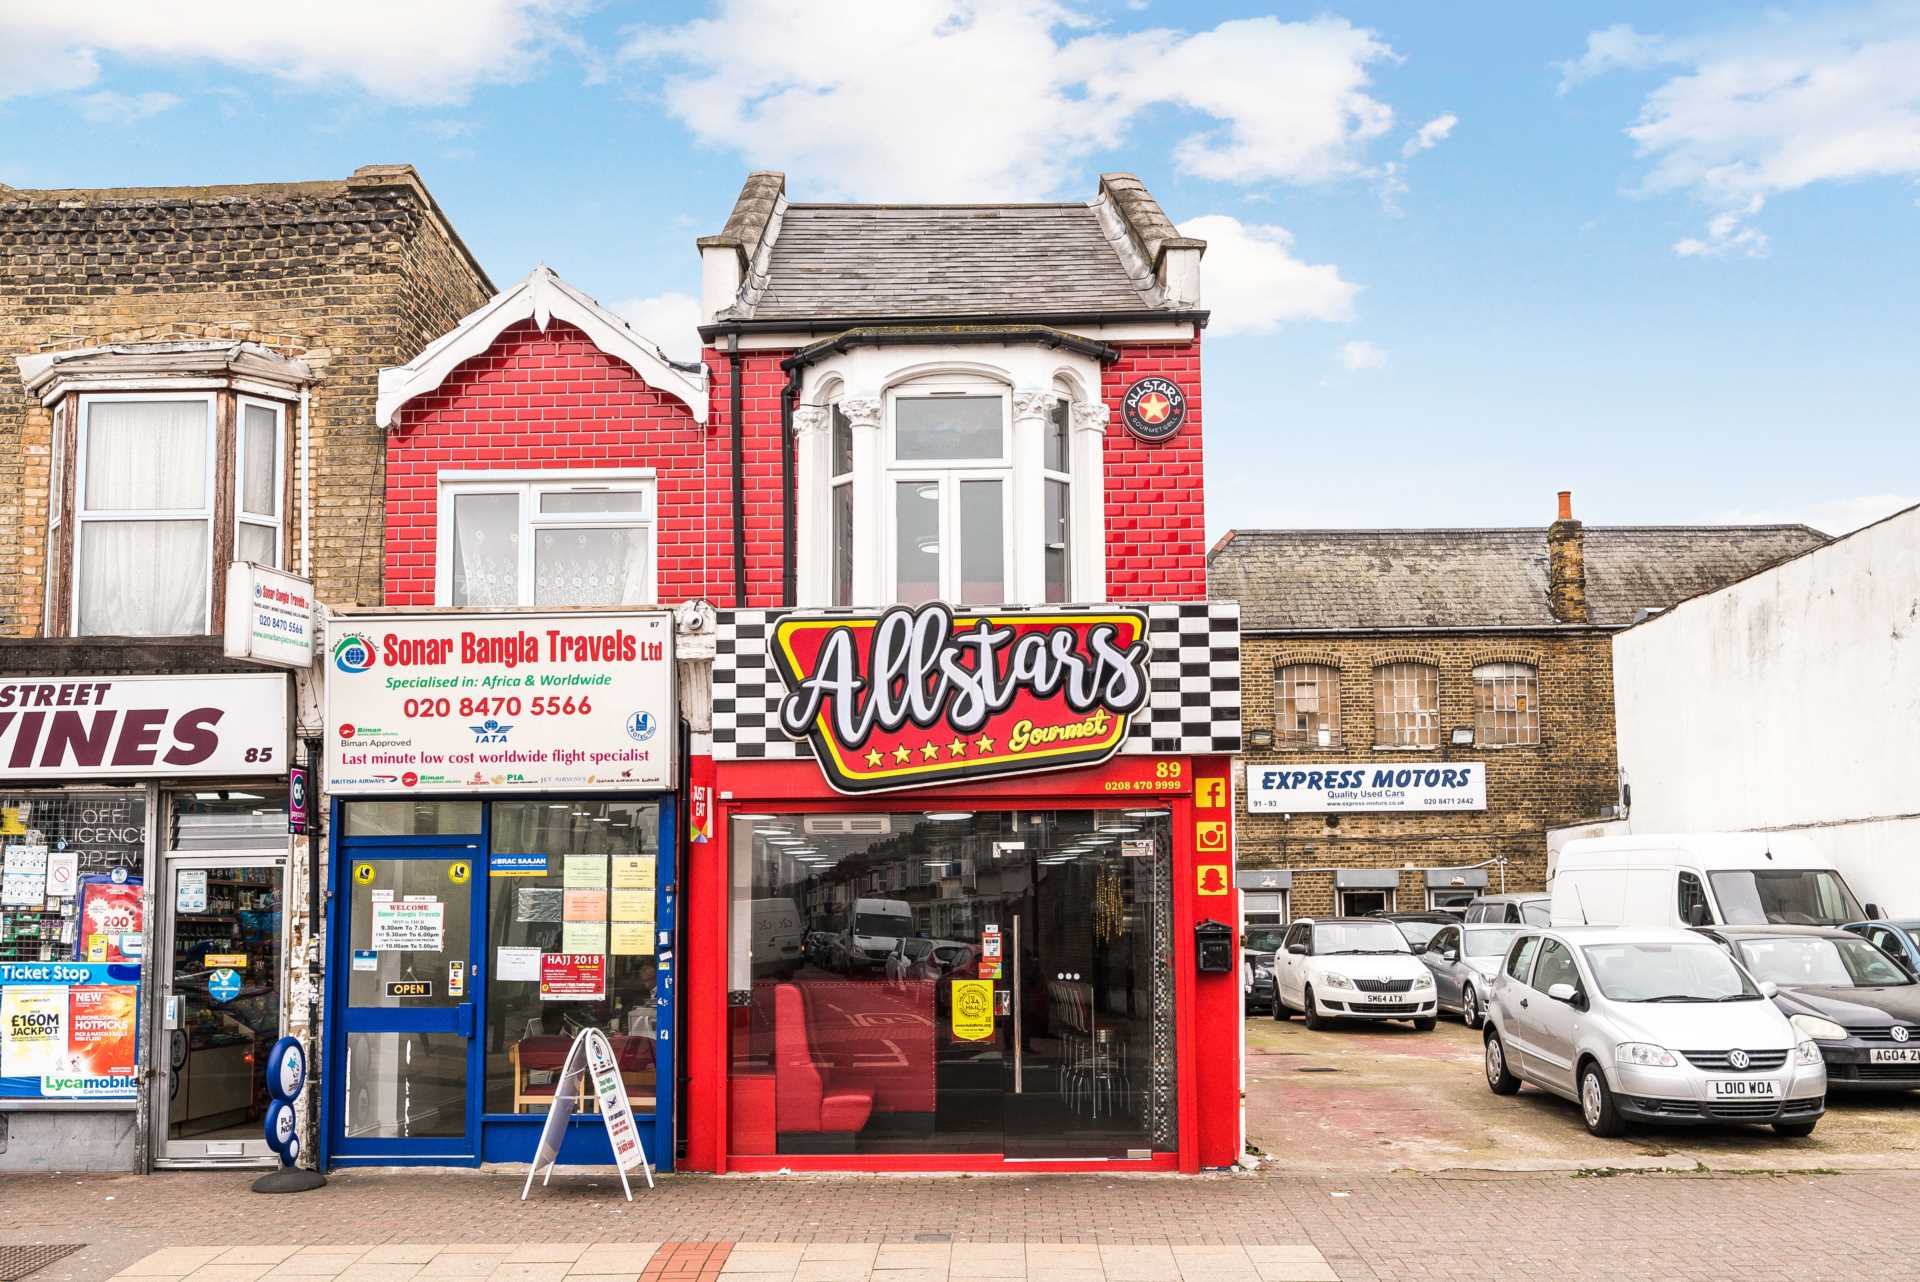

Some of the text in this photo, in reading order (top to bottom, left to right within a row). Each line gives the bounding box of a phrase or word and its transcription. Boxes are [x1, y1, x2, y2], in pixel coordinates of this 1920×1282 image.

[1127, 380, 1181, 408] ALLSTARS
[259, 614, 302, 634] 020 8470 5566
[383, 633, 454, 667] Sonar
[461, 630, 539, 669] Bangla
[546, 629, 637, 663] Travels
[640, 640, 663, 661] Ltd
[385, 673, 612, 691] Specialised in: Africa & Worldwide
[784, 605, 1147, 746] Allstars
[0, 683, 112, 707] STREET
[403, 695, 592, 718] 020 8470 5566
[0, 707, 225, 768] INES
[1008, 708, 1114, 752] Gourmet
[340, 739, 412, 749] Biman Approved
[475, 735, 507, 744] IATA
[244, 747, 273, 763] 85
[342, 748, 649, 766] Last minute low cost worldwide flight specialist
[506, 773, 525, 781] PIA
[1155, 761, 1182, 778] 89
[331, 776, 385, 785] BRITISH AIRWAYS
[1104, 780, 1181, 791] 0208 470 9999
[1262, 768, 1472, 791] EXPRESS MOTORS
[693, 785, 706, 802] JUST
[1327, 789, 1405, 801] Quality Used Cars
[1457, 797, 1475, 805] 2442
[82, 809, 124, 824] OFF
[695, 802, 706, 817] EAT
[103, 916, 130, 928] 200
[547, 955, 571, 966] HAJJ
[574, 955, 600, 965] 2018
[1, 965, 91, 983] Ticket Stop
[76, 991, 102, 1002] NEW
[394, 984, 425, 994] OPEN
[11, 1013, 59, 1026] £160M
[75, 1020, 129, 1030] HOTPICKS
[11, 1026, 60, 1036] JACKPOT
[1876, 1050, 1920, 1061] AG04 Z
[45, 1075, 138, 1091] Lycamobile
[1748, 1082, 1773, 1094] WOA
